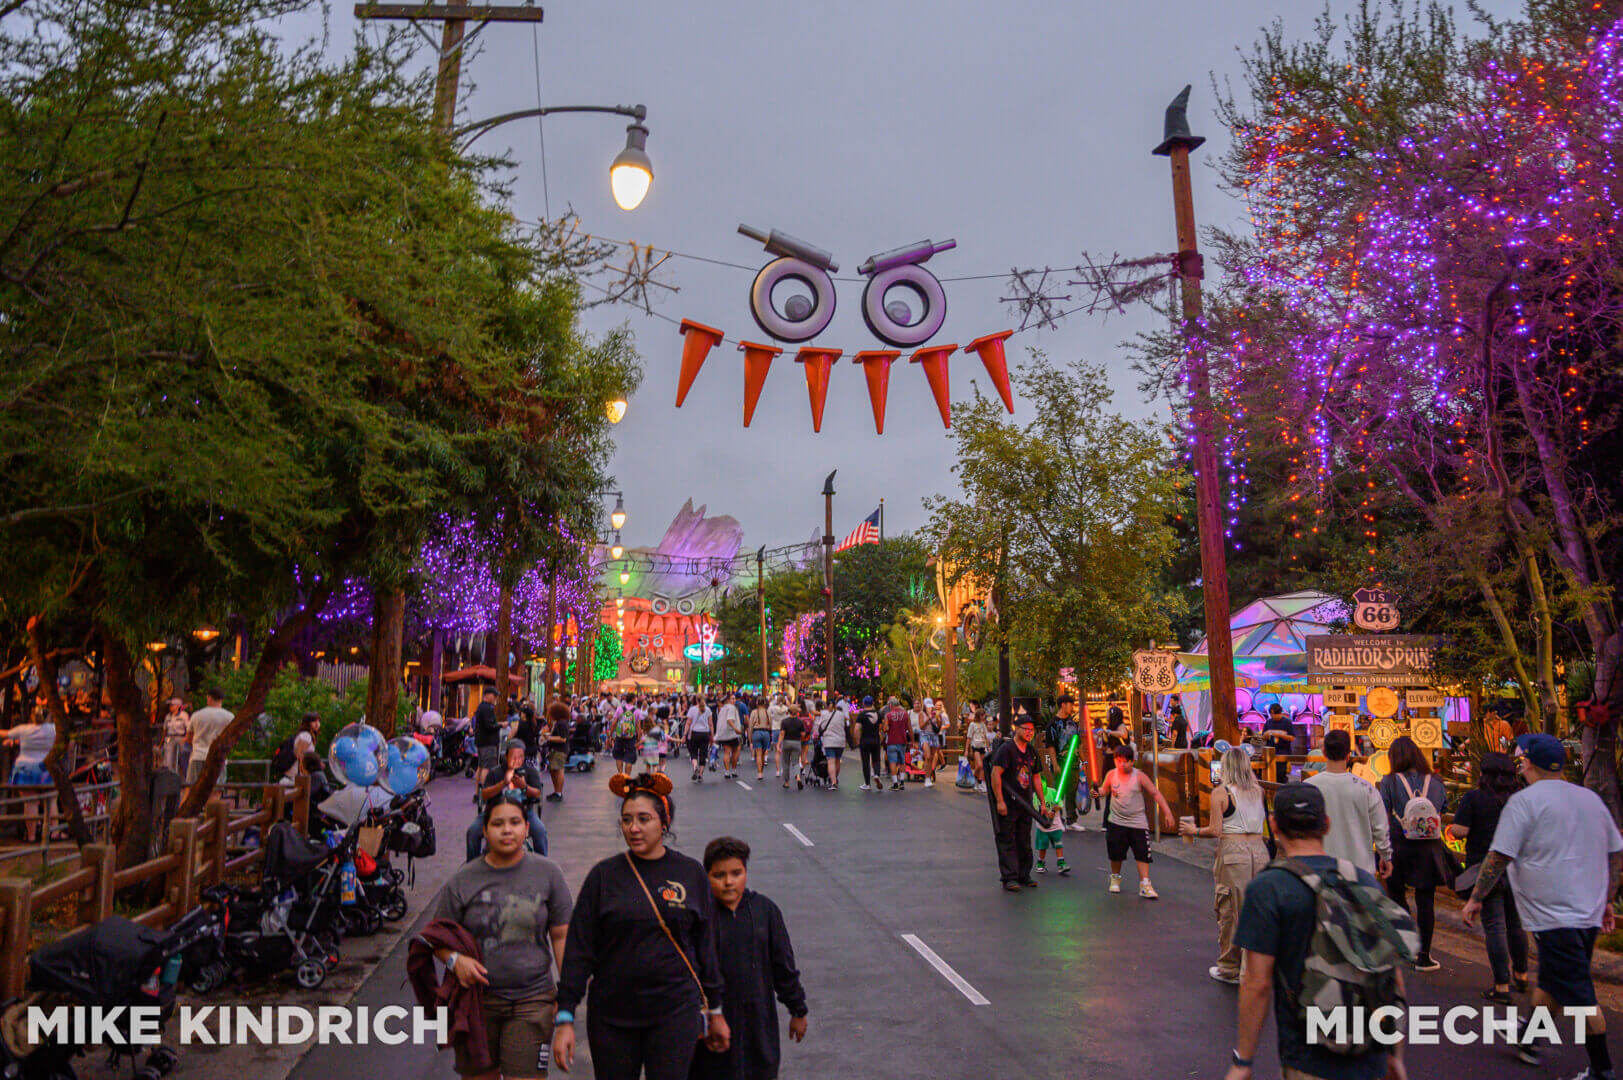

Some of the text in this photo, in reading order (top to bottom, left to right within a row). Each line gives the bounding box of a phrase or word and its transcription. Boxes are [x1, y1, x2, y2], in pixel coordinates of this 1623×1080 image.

[1368, 592, 1385, 602] US
[1363, 606, 1391, 623] 66
[1353, 639, 1392, 647] WELCOME
[1142, 656, 1168, 664] ROUTE
[1314, 647, 1381, 670] RADIATOR
[1140, 666, 1171, 687] 66
[1316, 676, 1354, 684] GATEWAY
[1357, 676, 1367, 684] TO
[1370, 676, 1416, 684] ORNAMENT
